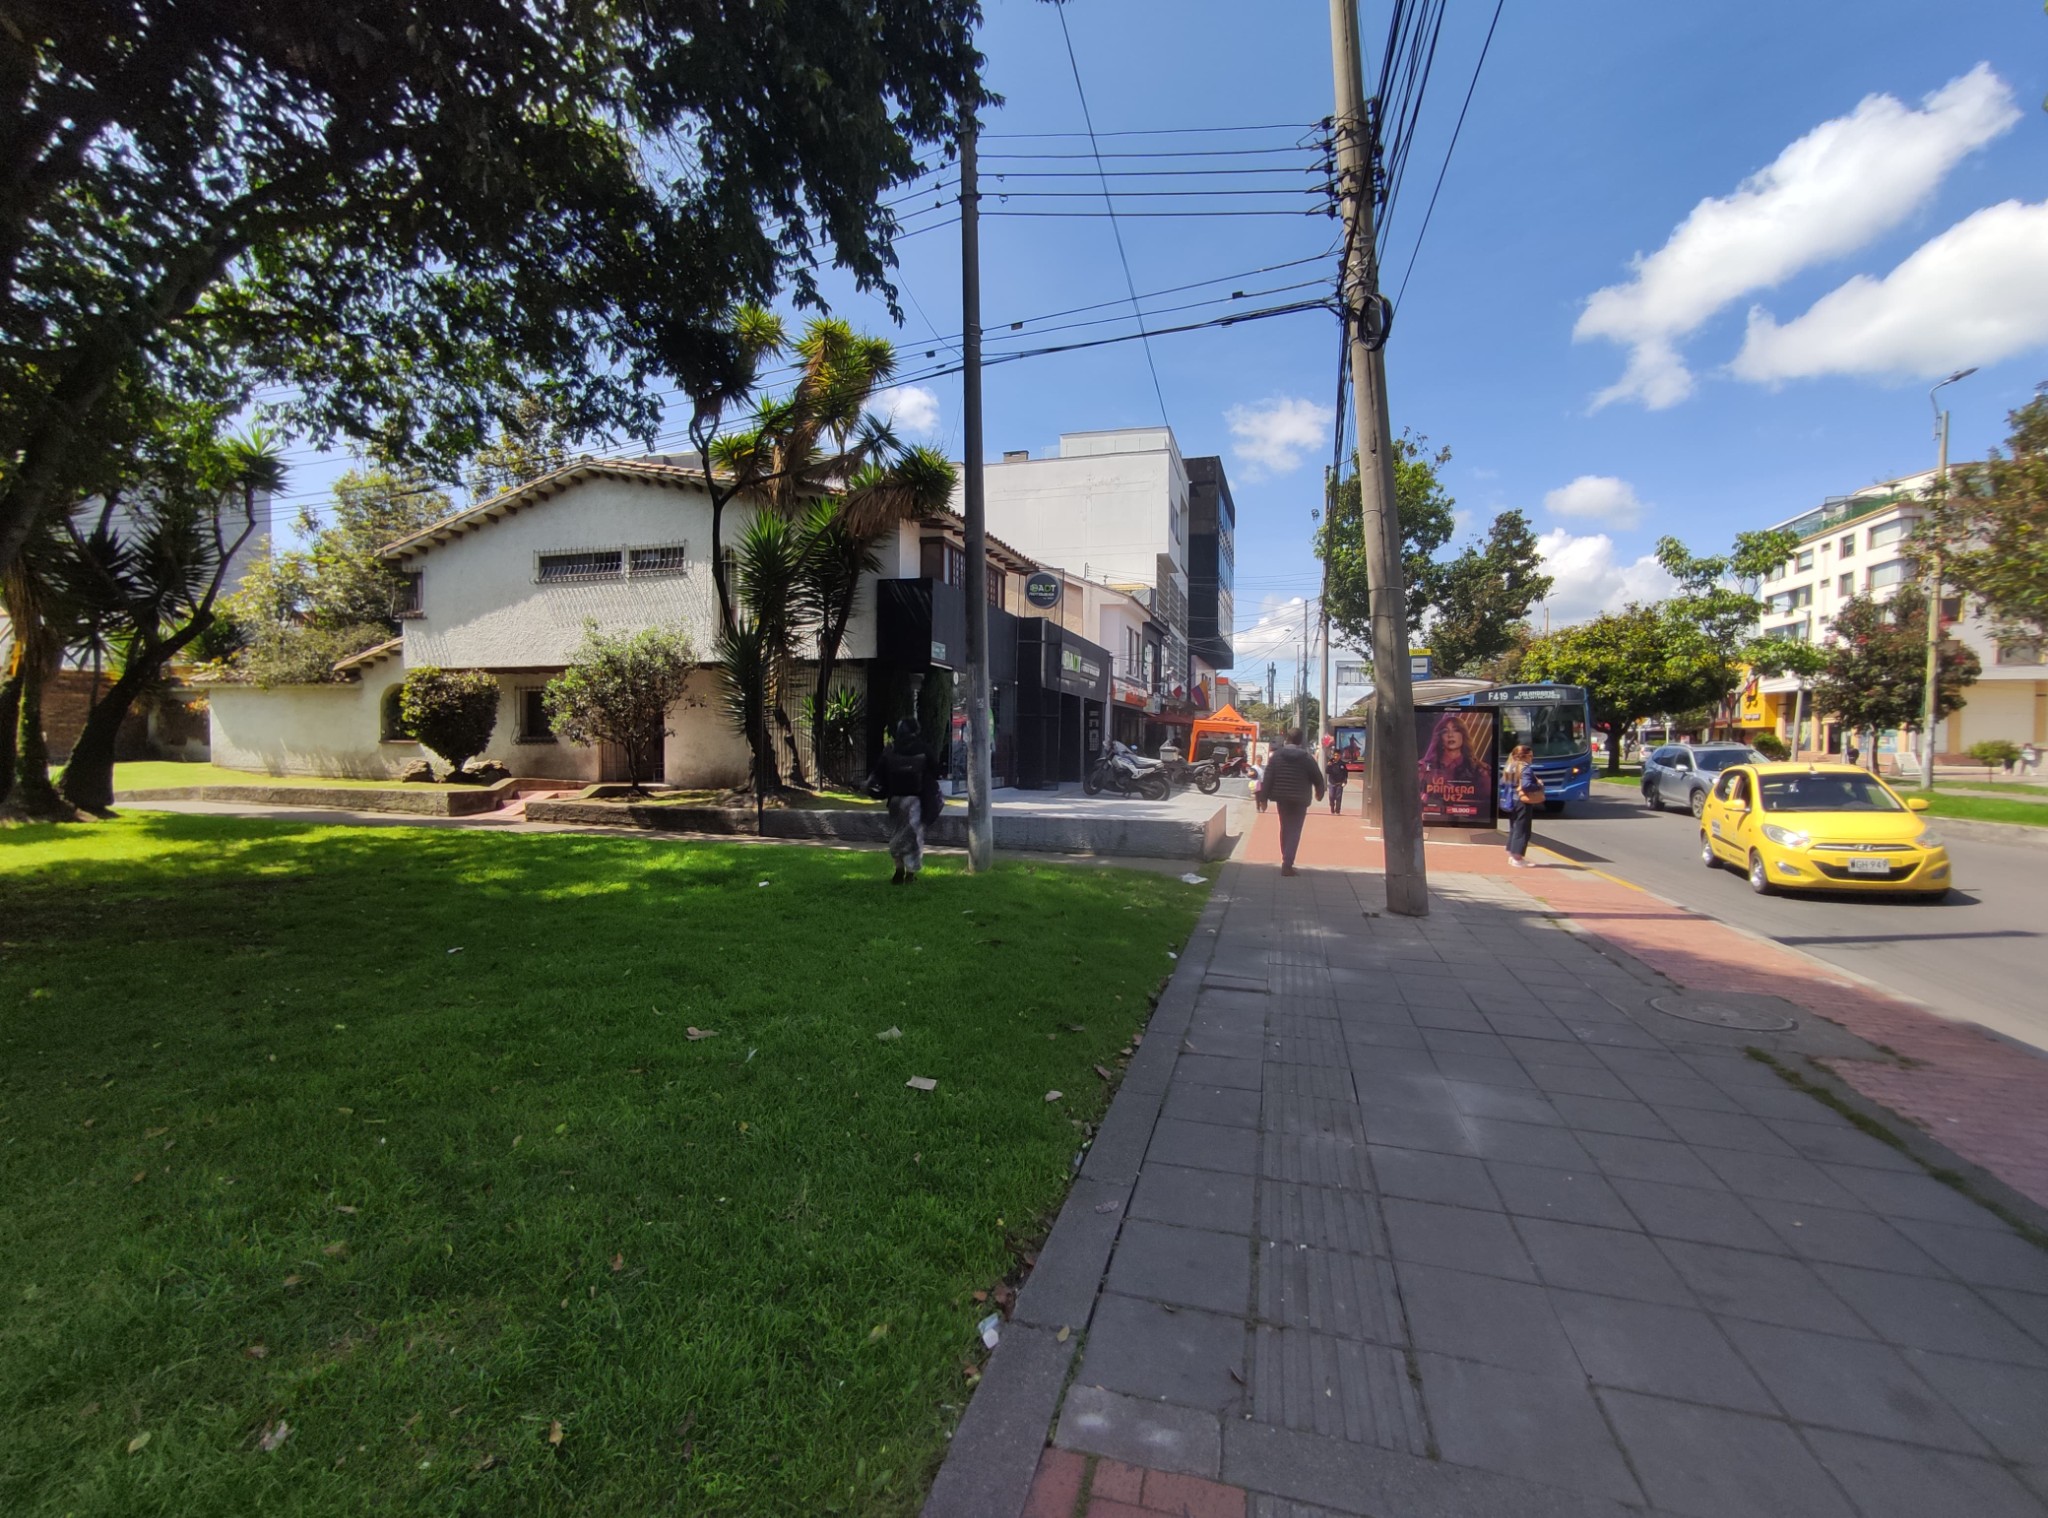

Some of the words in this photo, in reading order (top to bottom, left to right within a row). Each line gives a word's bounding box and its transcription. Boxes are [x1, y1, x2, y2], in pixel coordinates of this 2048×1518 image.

[1488, 692, 1509, 700] F419
[1432, 776, 1444, 785] LA
[1426, 784, 1475, 795] PRIMERA
